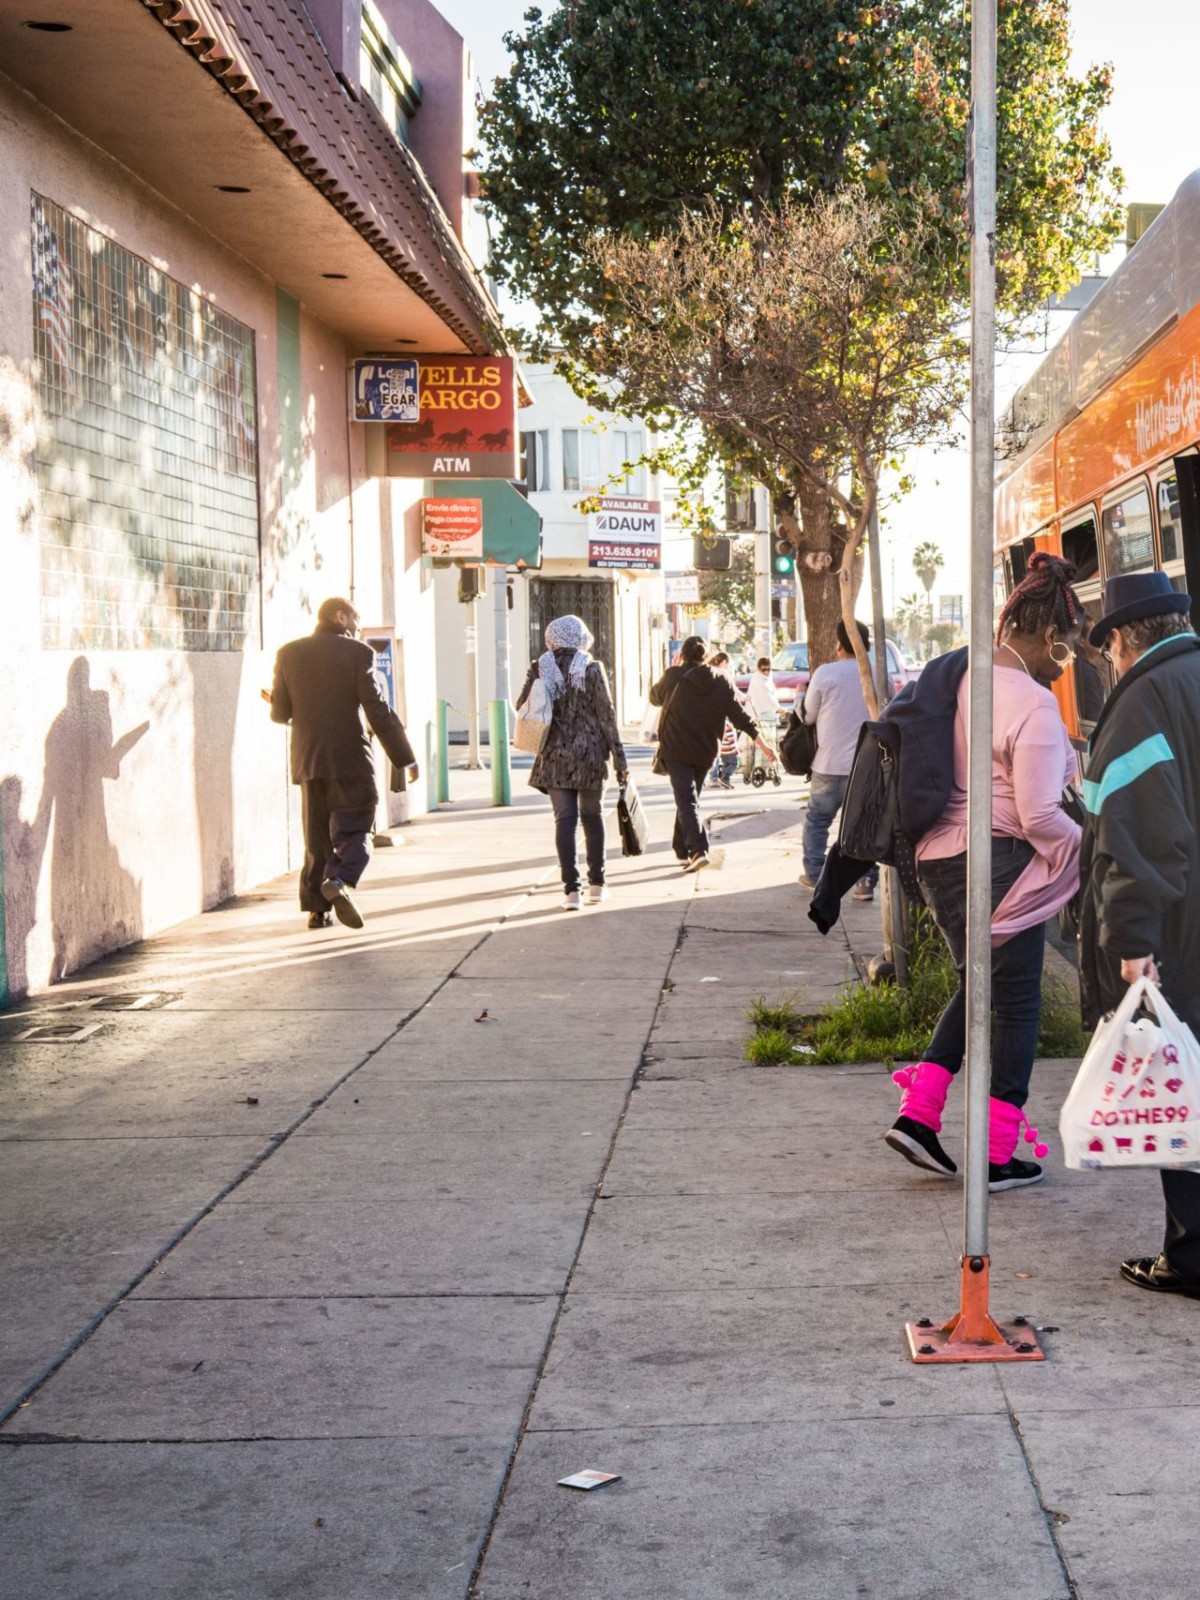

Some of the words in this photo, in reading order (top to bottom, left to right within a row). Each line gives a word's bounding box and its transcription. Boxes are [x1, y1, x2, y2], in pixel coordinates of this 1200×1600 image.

[378, 366, 415, 379] Loal
[382, 393, 416, 405] EGAR
[419, 389, 501, 410] ARGO
[432, 457, 471, 472] ATM
[601, 499, 649, 511] AVAILABLE
[609, 516, 655, 532] DAUM
[592, 546, 658, 558] 213.626.9101
